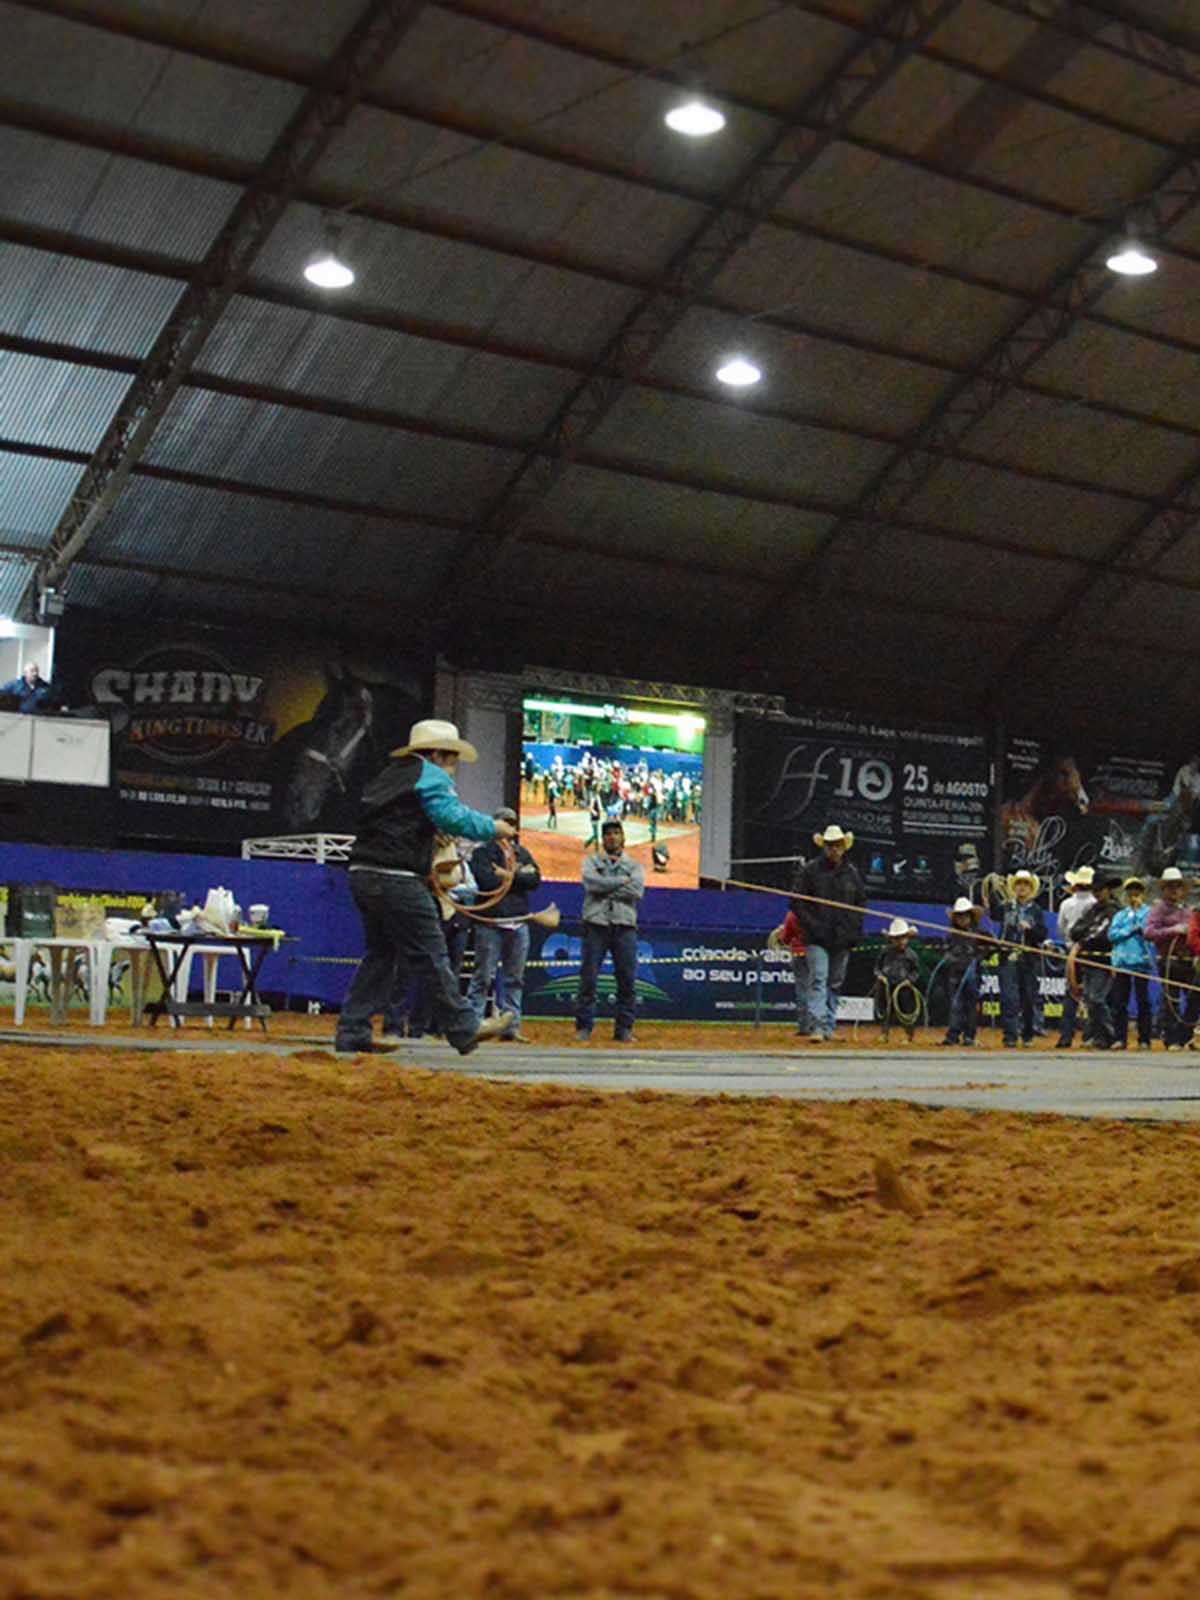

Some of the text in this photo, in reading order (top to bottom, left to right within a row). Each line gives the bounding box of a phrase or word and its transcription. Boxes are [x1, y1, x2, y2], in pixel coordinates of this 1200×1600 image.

[902, 763, 929, 793] 25
[946, 781, 989, 798] AGOSTO
[682, 967, 706, 981] ao
[709, 969, 743, 982] seu
